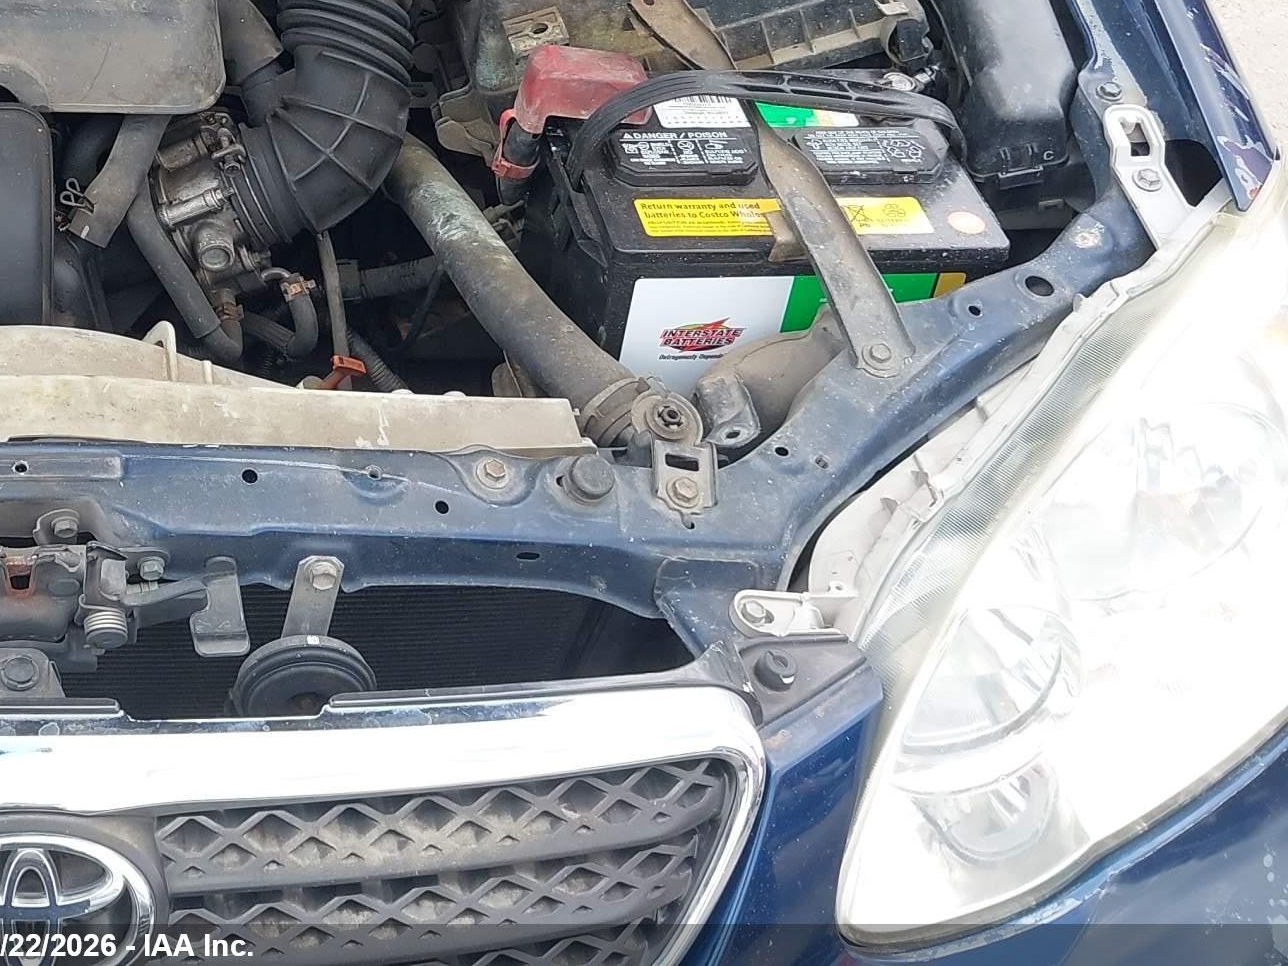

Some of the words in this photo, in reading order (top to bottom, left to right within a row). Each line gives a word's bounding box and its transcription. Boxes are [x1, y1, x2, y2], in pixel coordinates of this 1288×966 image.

[688, 131, 728, 139] POISON
[641, 202, 674, 210] Return
[675, 203, 717, 212] warranty
[738, 202, 760, 210] used
[644, 211, 686, 219] batteries
[663, 329, 743, 338] INTERSTATE
[663, 337, 734, 346] BATTERIES
